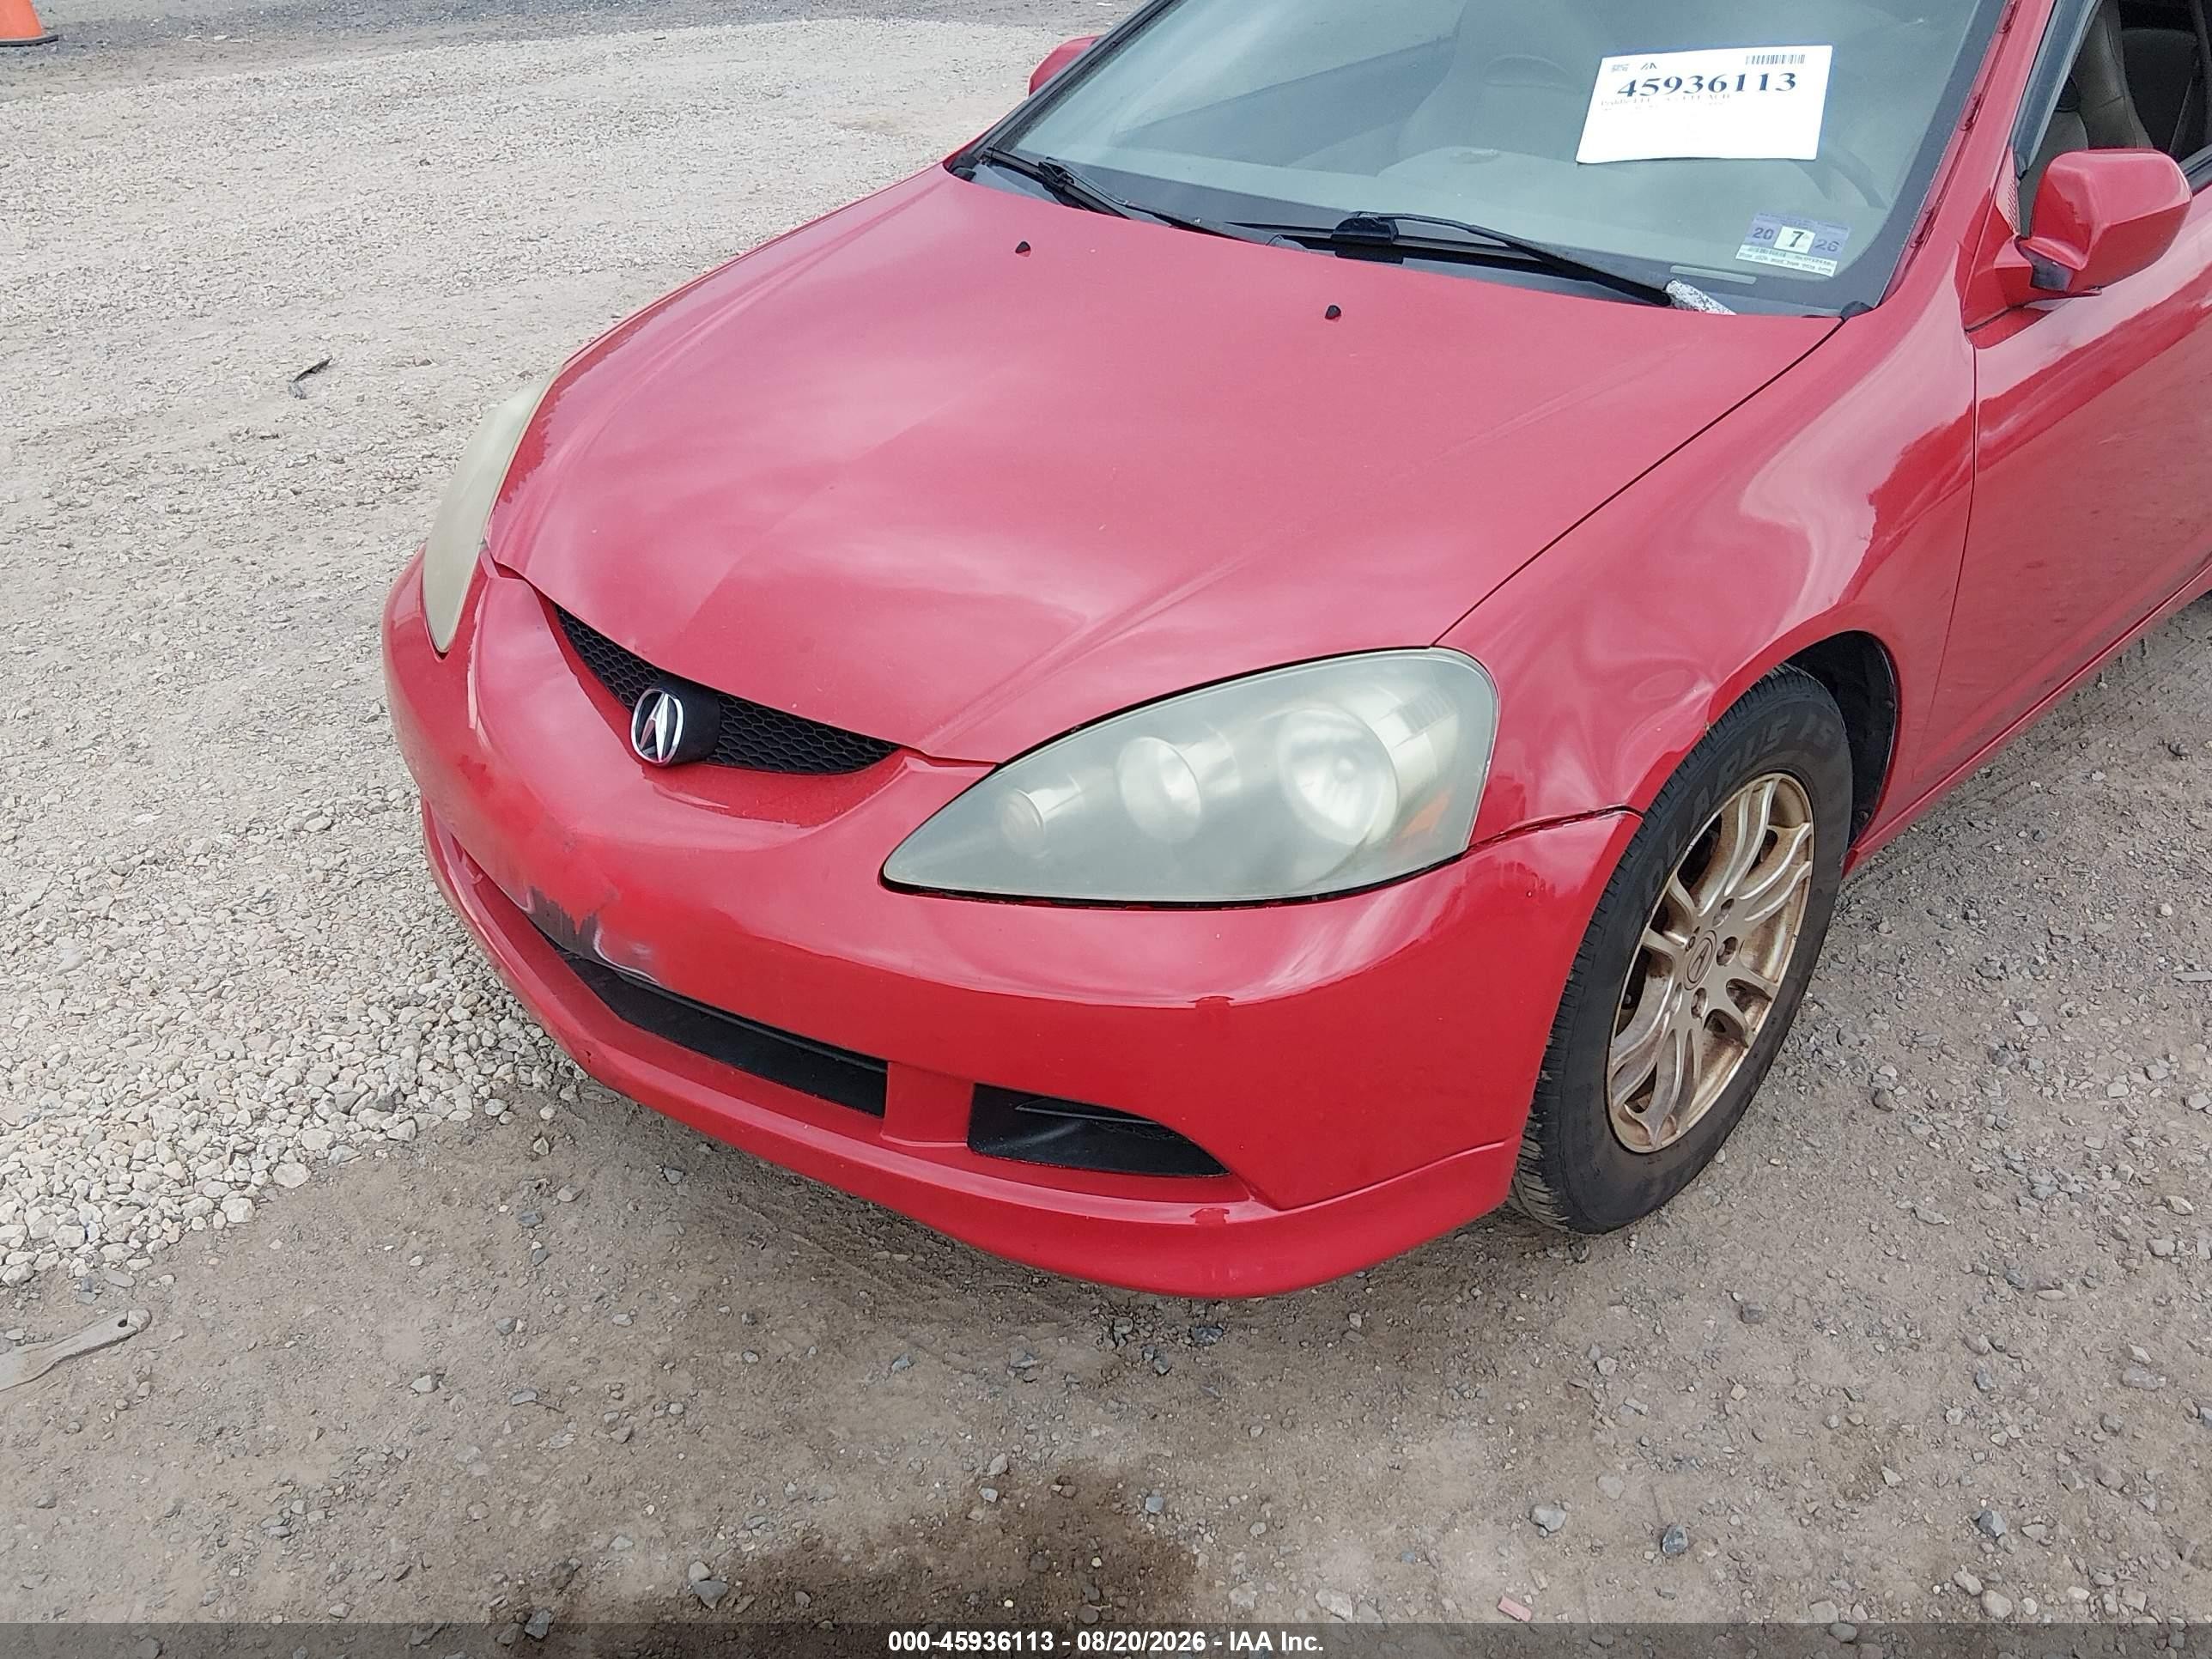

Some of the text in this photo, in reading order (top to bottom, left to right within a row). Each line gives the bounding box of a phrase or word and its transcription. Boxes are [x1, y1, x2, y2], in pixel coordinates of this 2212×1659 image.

[1616, 72, 1797, 98] 45936113
[1753, 227, 1775, 240] 20
[1789, 230, 1805, 248] 7
